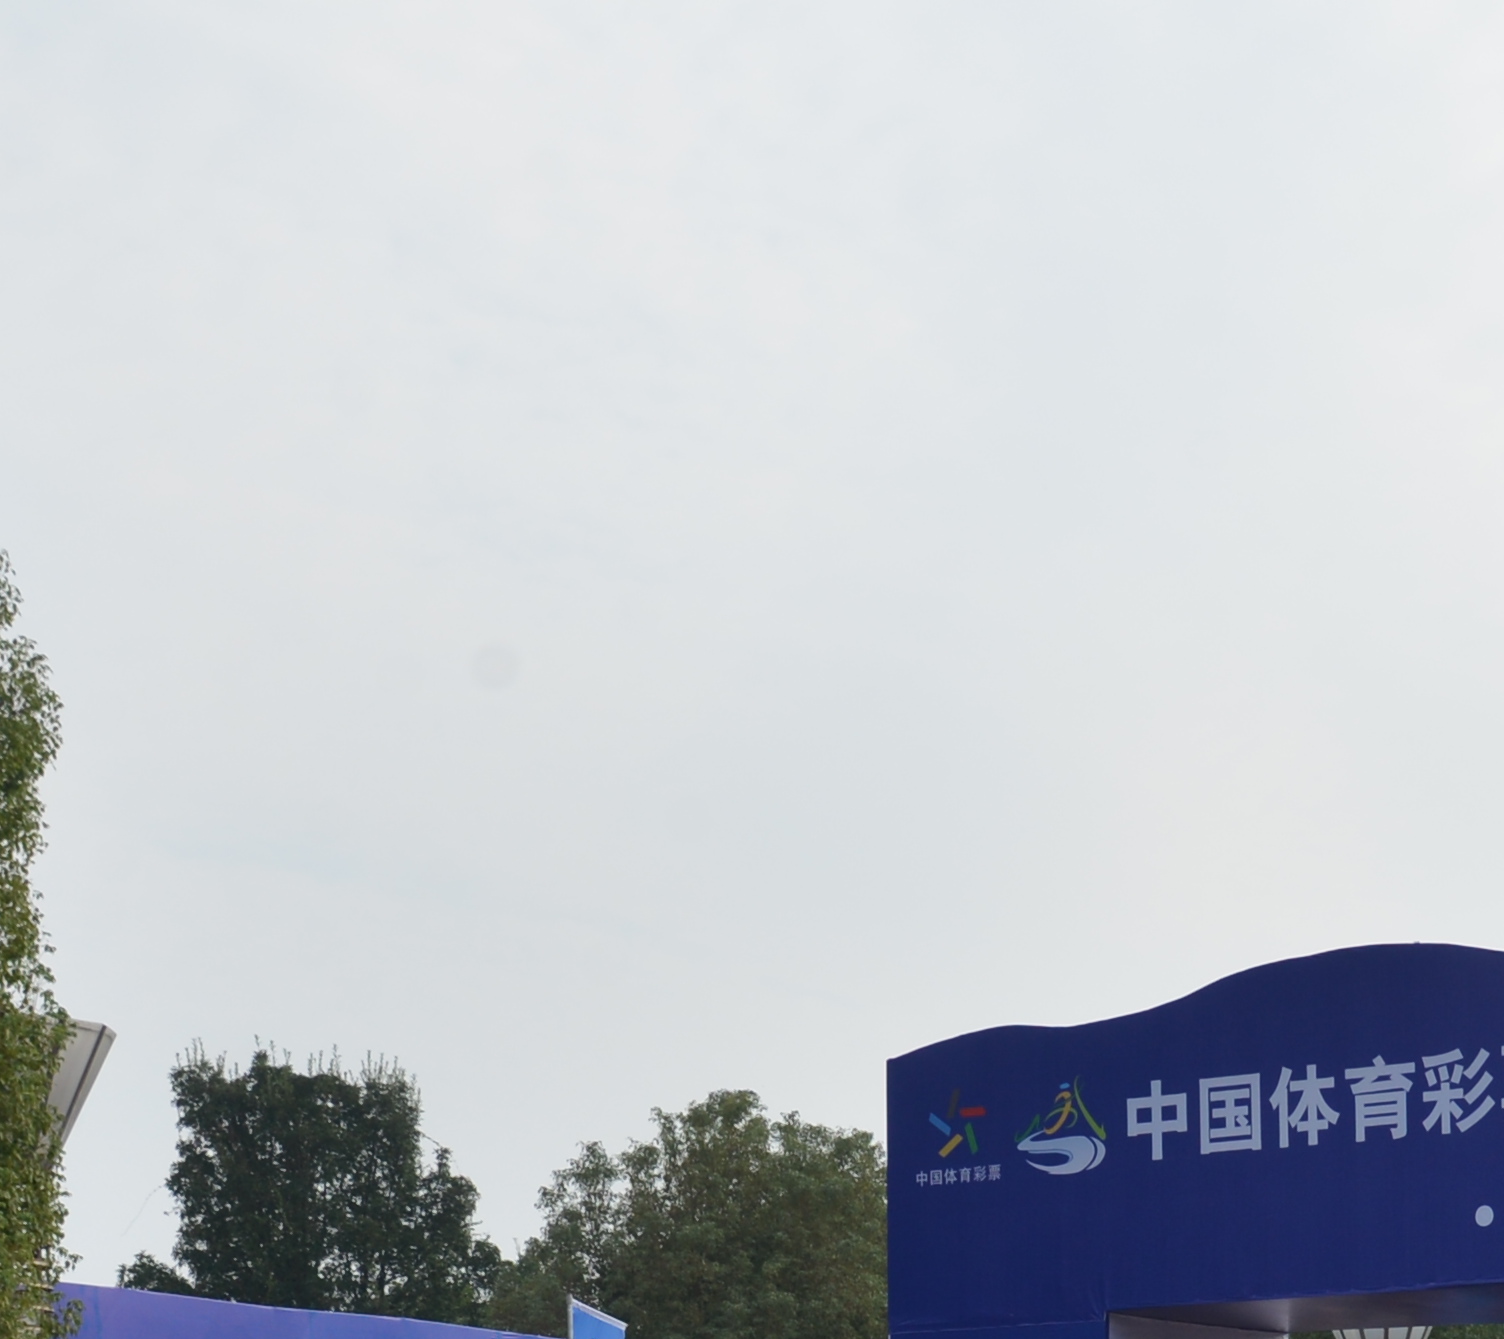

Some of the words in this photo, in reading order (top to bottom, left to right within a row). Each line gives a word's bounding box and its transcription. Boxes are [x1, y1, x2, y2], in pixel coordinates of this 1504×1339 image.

[915, 1163, 1002, 1188] 中国体育彩票
